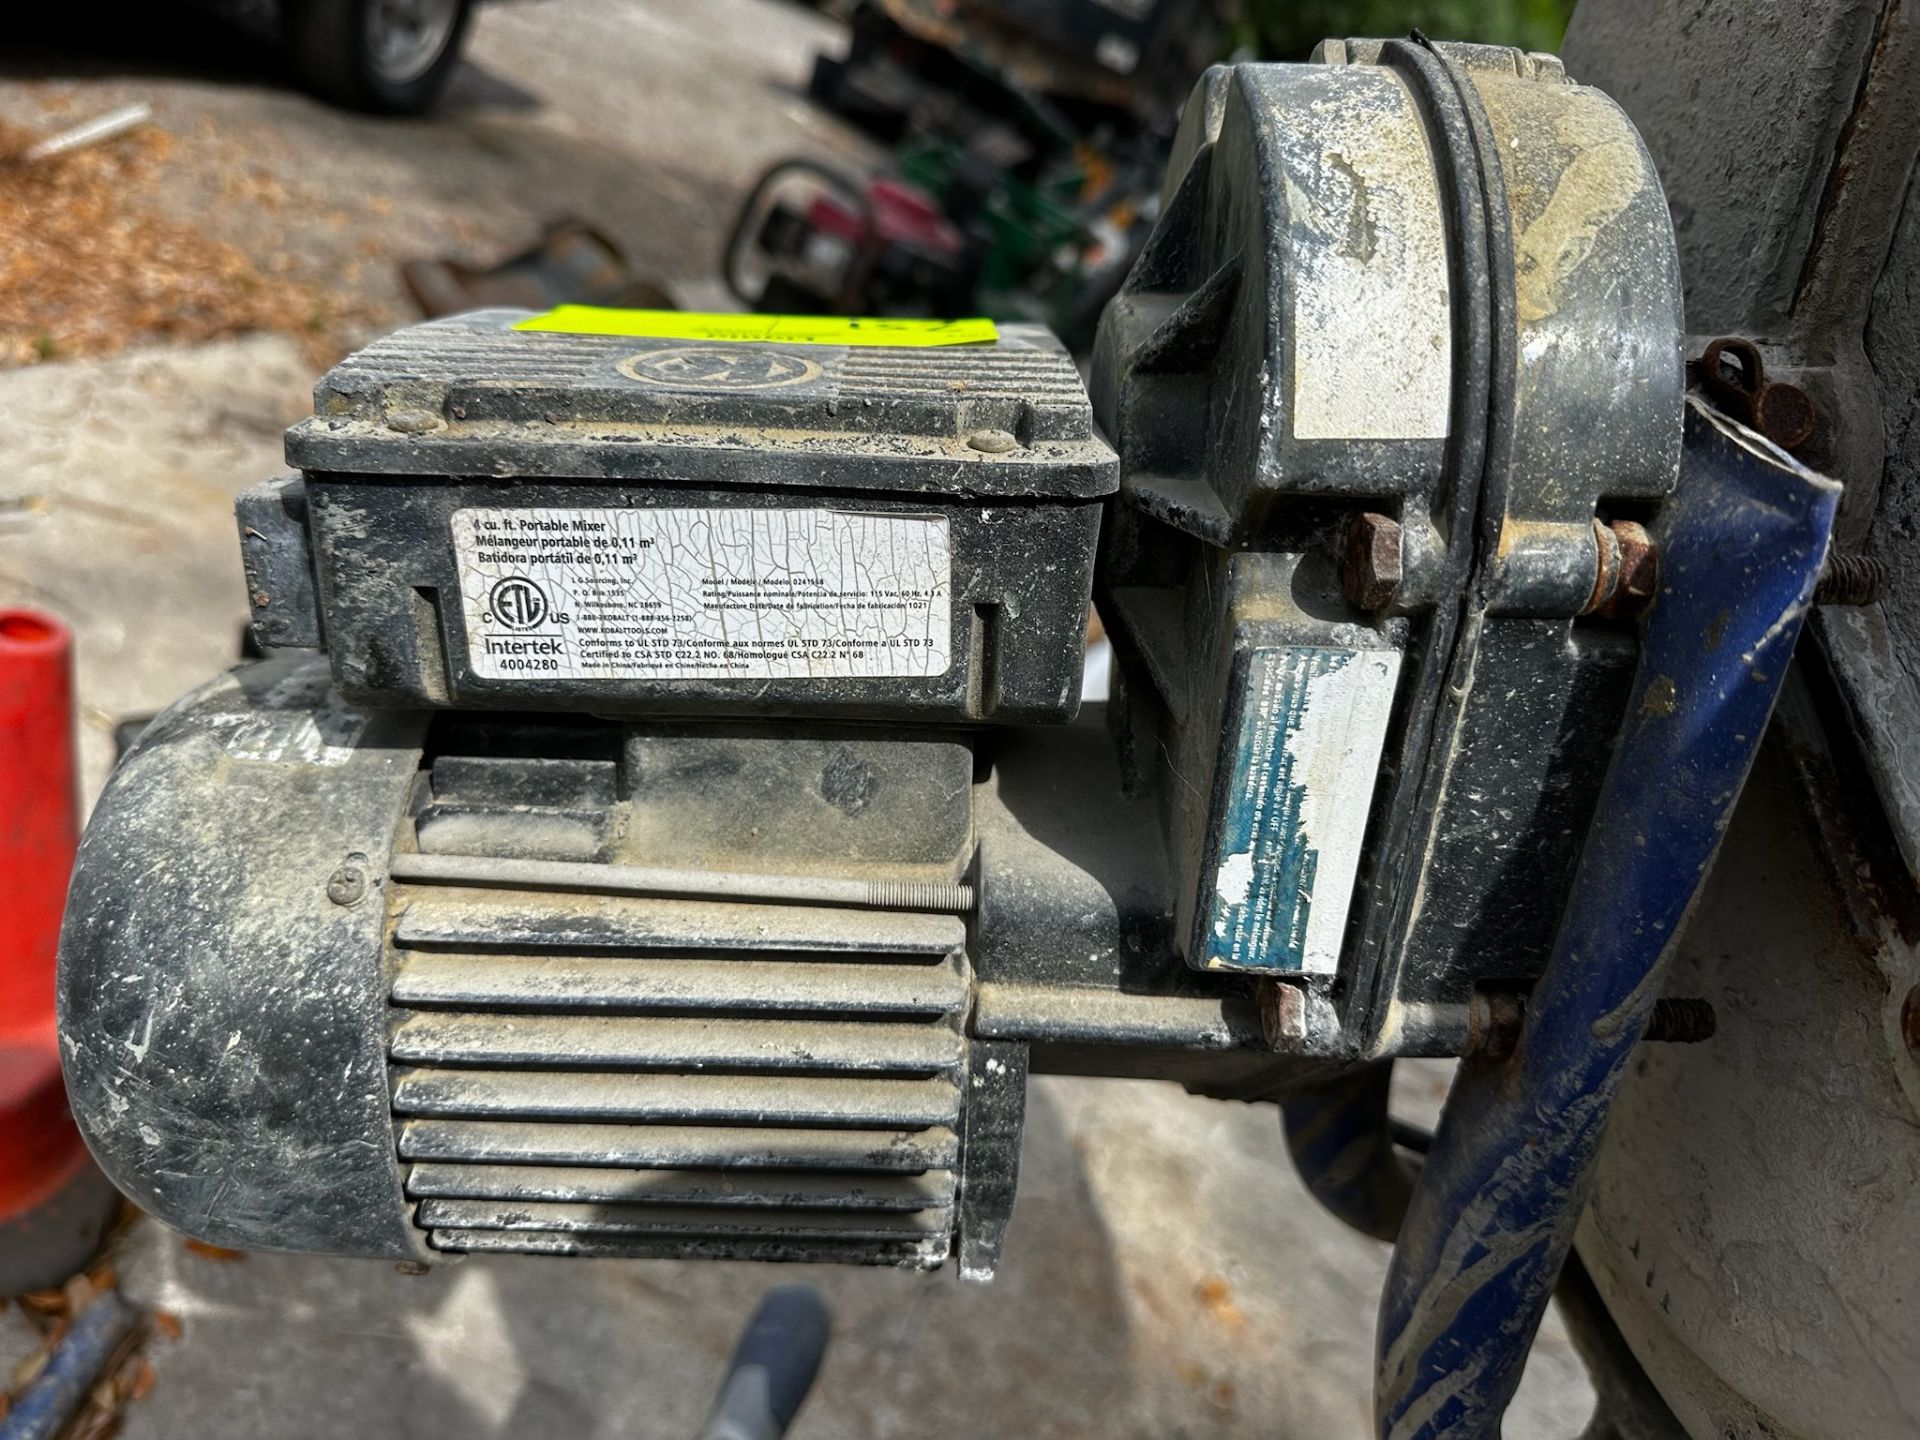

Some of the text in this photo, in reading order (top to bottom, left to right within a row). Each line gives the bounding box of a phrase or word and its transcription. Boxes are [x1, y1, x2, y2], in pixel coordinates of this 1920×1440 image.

[485, 520, 500, 531] cu.
[503, 519, 516, 531] ft.
[520, 520, 569, 532] Portable
[572, 520, 605, 532] Mixer
[476, 535, 538, 550] Mélangeur
[542, 537, 590, 551] portable
[593, 537, 608, 548] de
[611, 537, 635, 549] 0,11
[478, 552, 527, 564] Batidora
[531, 552, 574, 566] portátil
[577, 553, 591, 564] de
[594, 553, 618, 565] 0,11
[550, 612, 570, 624] US
[485, 638, 563, 654] Intertek
[579, 639, 622, 647] Conforms
[652, 639, 669, 647] STD
[672, 639, 730, 648] 73/Conforme
[732, 640, 749, 648] aux
[822, 639, 879, 648] 73/Conforme
[890, 639, 901, 647] UL
[904, 639, 920, 647] STD
[923, 639, 934, 647] 73
[580, 650, 620, 659] Certified
[622, 650, 632, 659] to
[634, 651, 652, 659] CSA
[655, 651, 672, 659] STD
[675, 651, 701, 659] C22.2
[703, 651, 721, 659] NO.
[791, 651, 809, 659] CSA
[811, 651, 836, 659] C22.2
[852, 651, 864, 659] 68
[500, 659, 558, 670] 4004280
[1264, 726, 1279, 761] desechar
